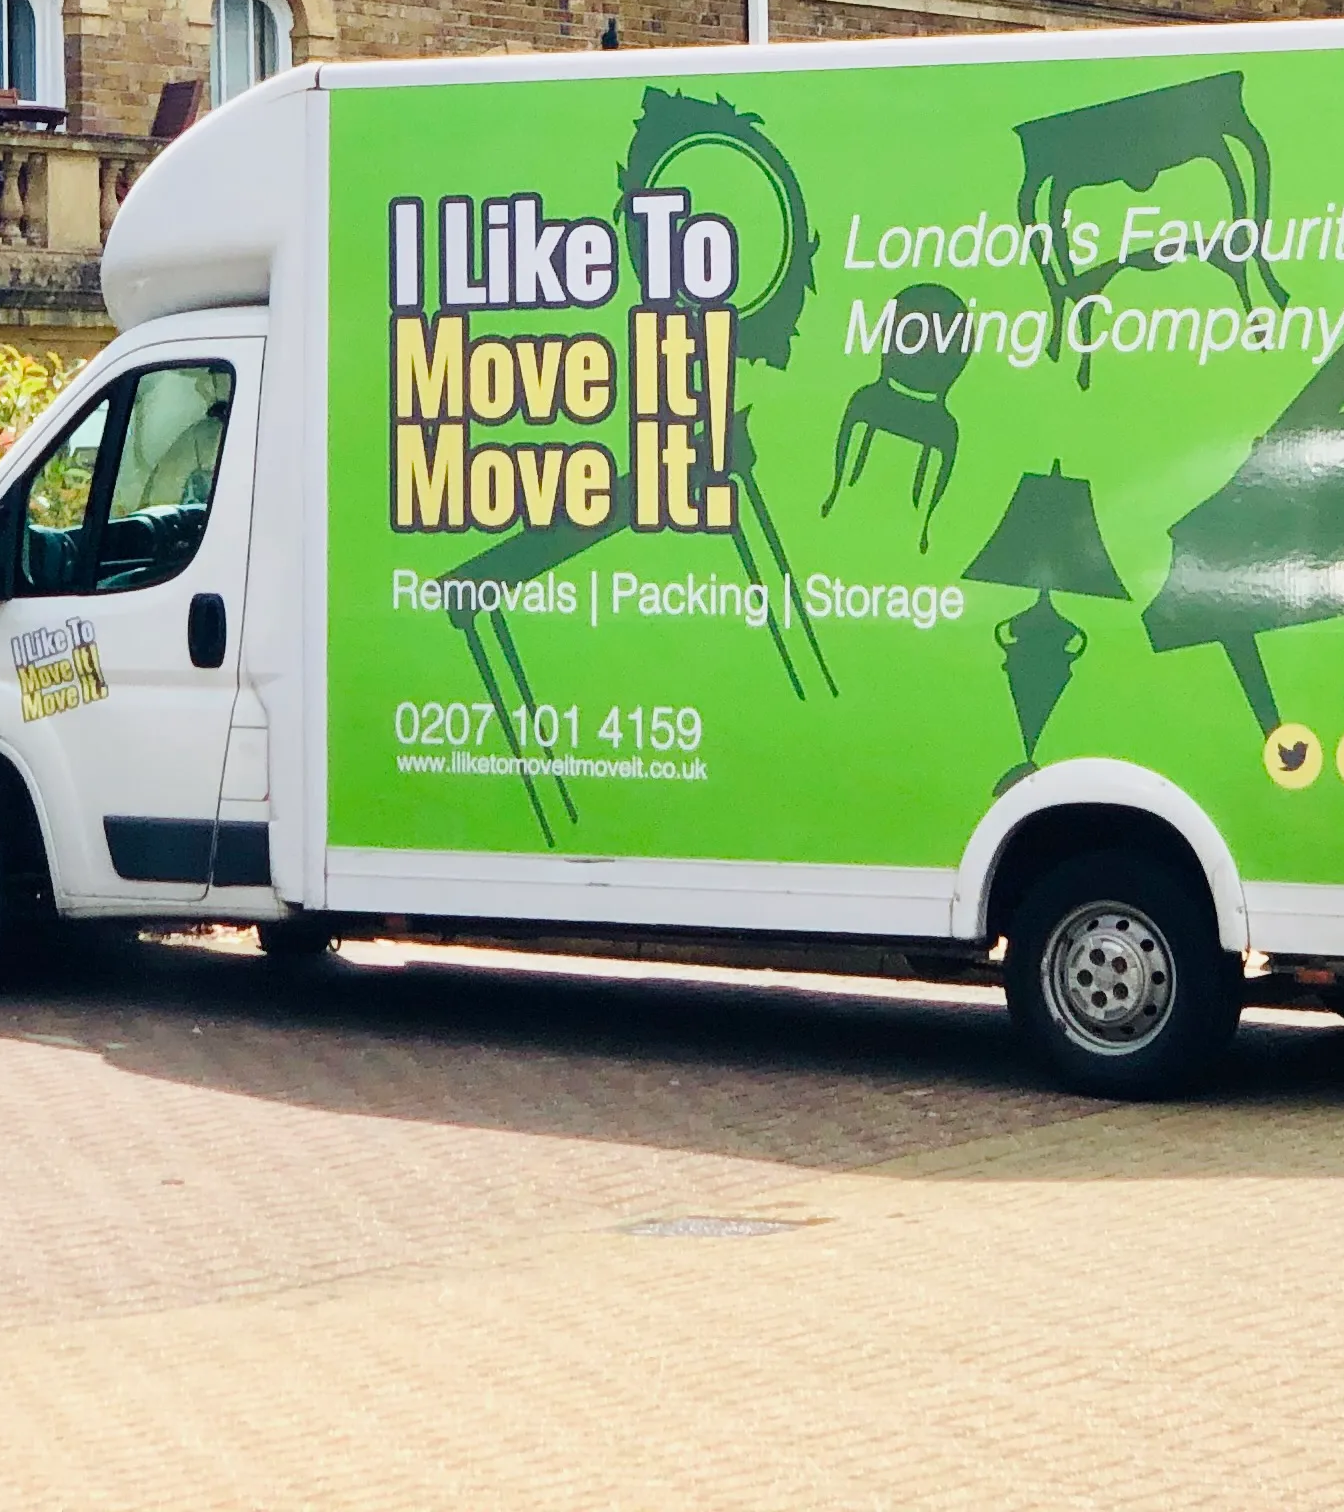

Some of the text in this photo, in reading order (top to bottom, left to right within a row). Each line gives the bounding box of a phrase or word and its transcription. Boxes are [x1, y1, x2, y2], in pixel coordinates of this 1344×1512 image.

[390, 189, 737, 309] I Like To
[844, 208, 1100, 270] London's
[844, 297, 1048, 368] Moving
[392, 310, 615, 425] Move
[392, 419, 615, 532] Move
[392, 570, 577, 614] Removals
[612, 572, 768, 627] Packing
[805, 574, 964, 630] Storage
[11, 616, 95, 666] I Like To
[17, 659, 74, 694] Move
[22, 684, 79, 723] Move
[394, 701, 702, 751] 0207 101 4159
